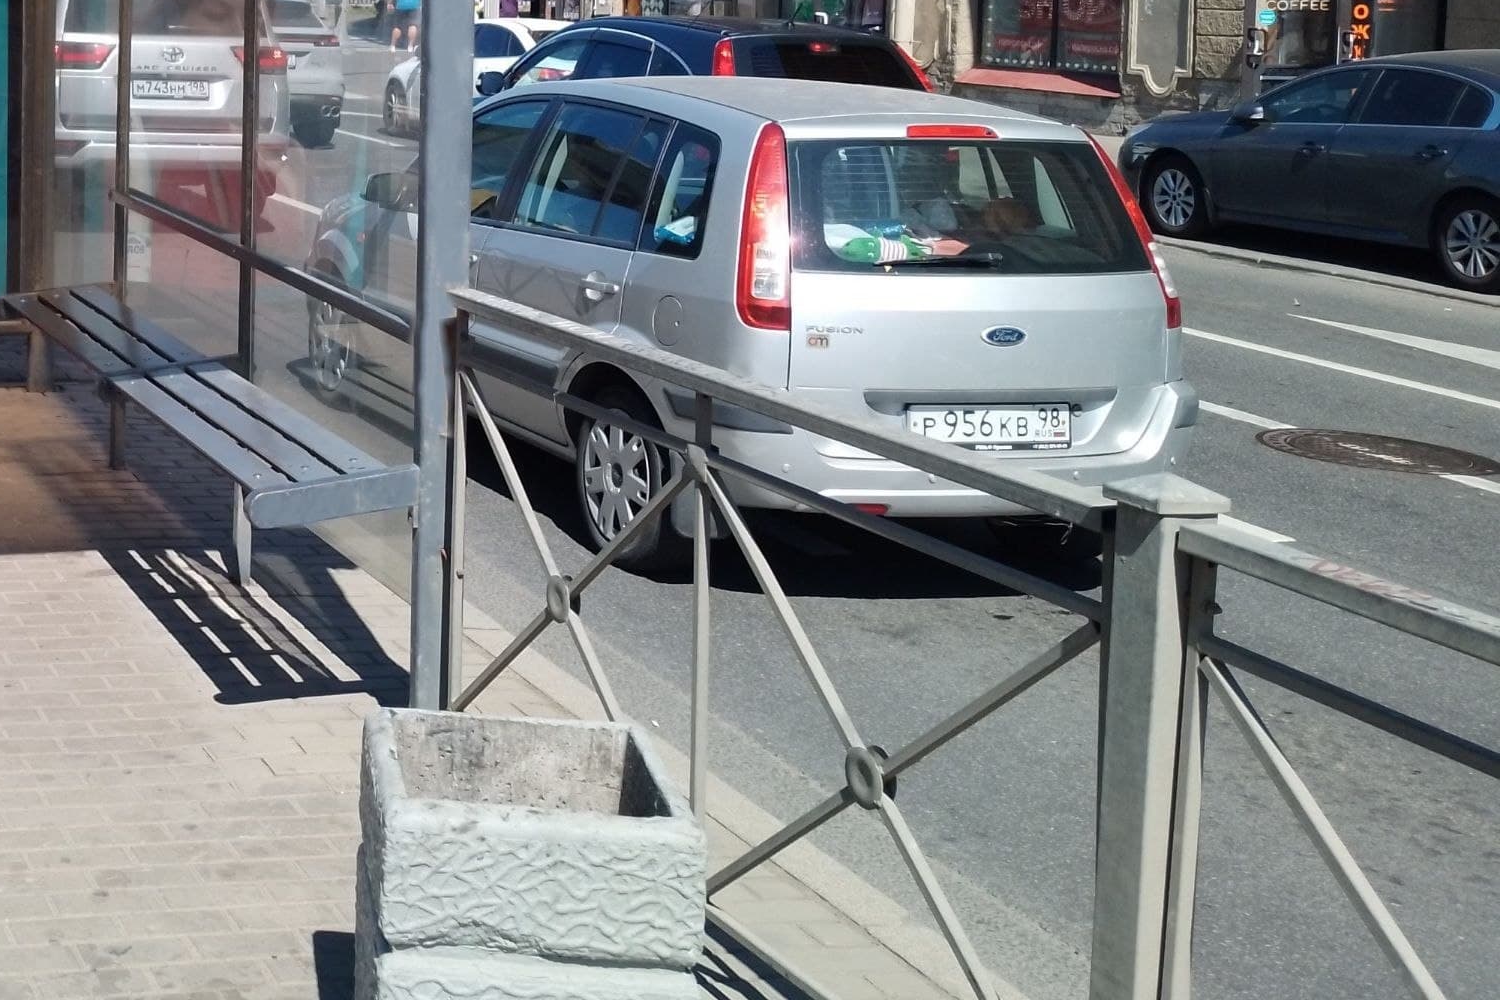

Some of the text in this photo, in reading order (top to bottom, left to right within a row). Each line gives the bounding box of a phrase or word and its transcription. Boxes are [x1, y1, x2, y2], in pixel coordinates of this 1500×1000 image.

[1266, 0, 1330, 12] COFFEE
[805, 325, 863, 334] FUSION
[992, 330, 1019, 342] Ford
[1038, 407, 1061, 428] 98
